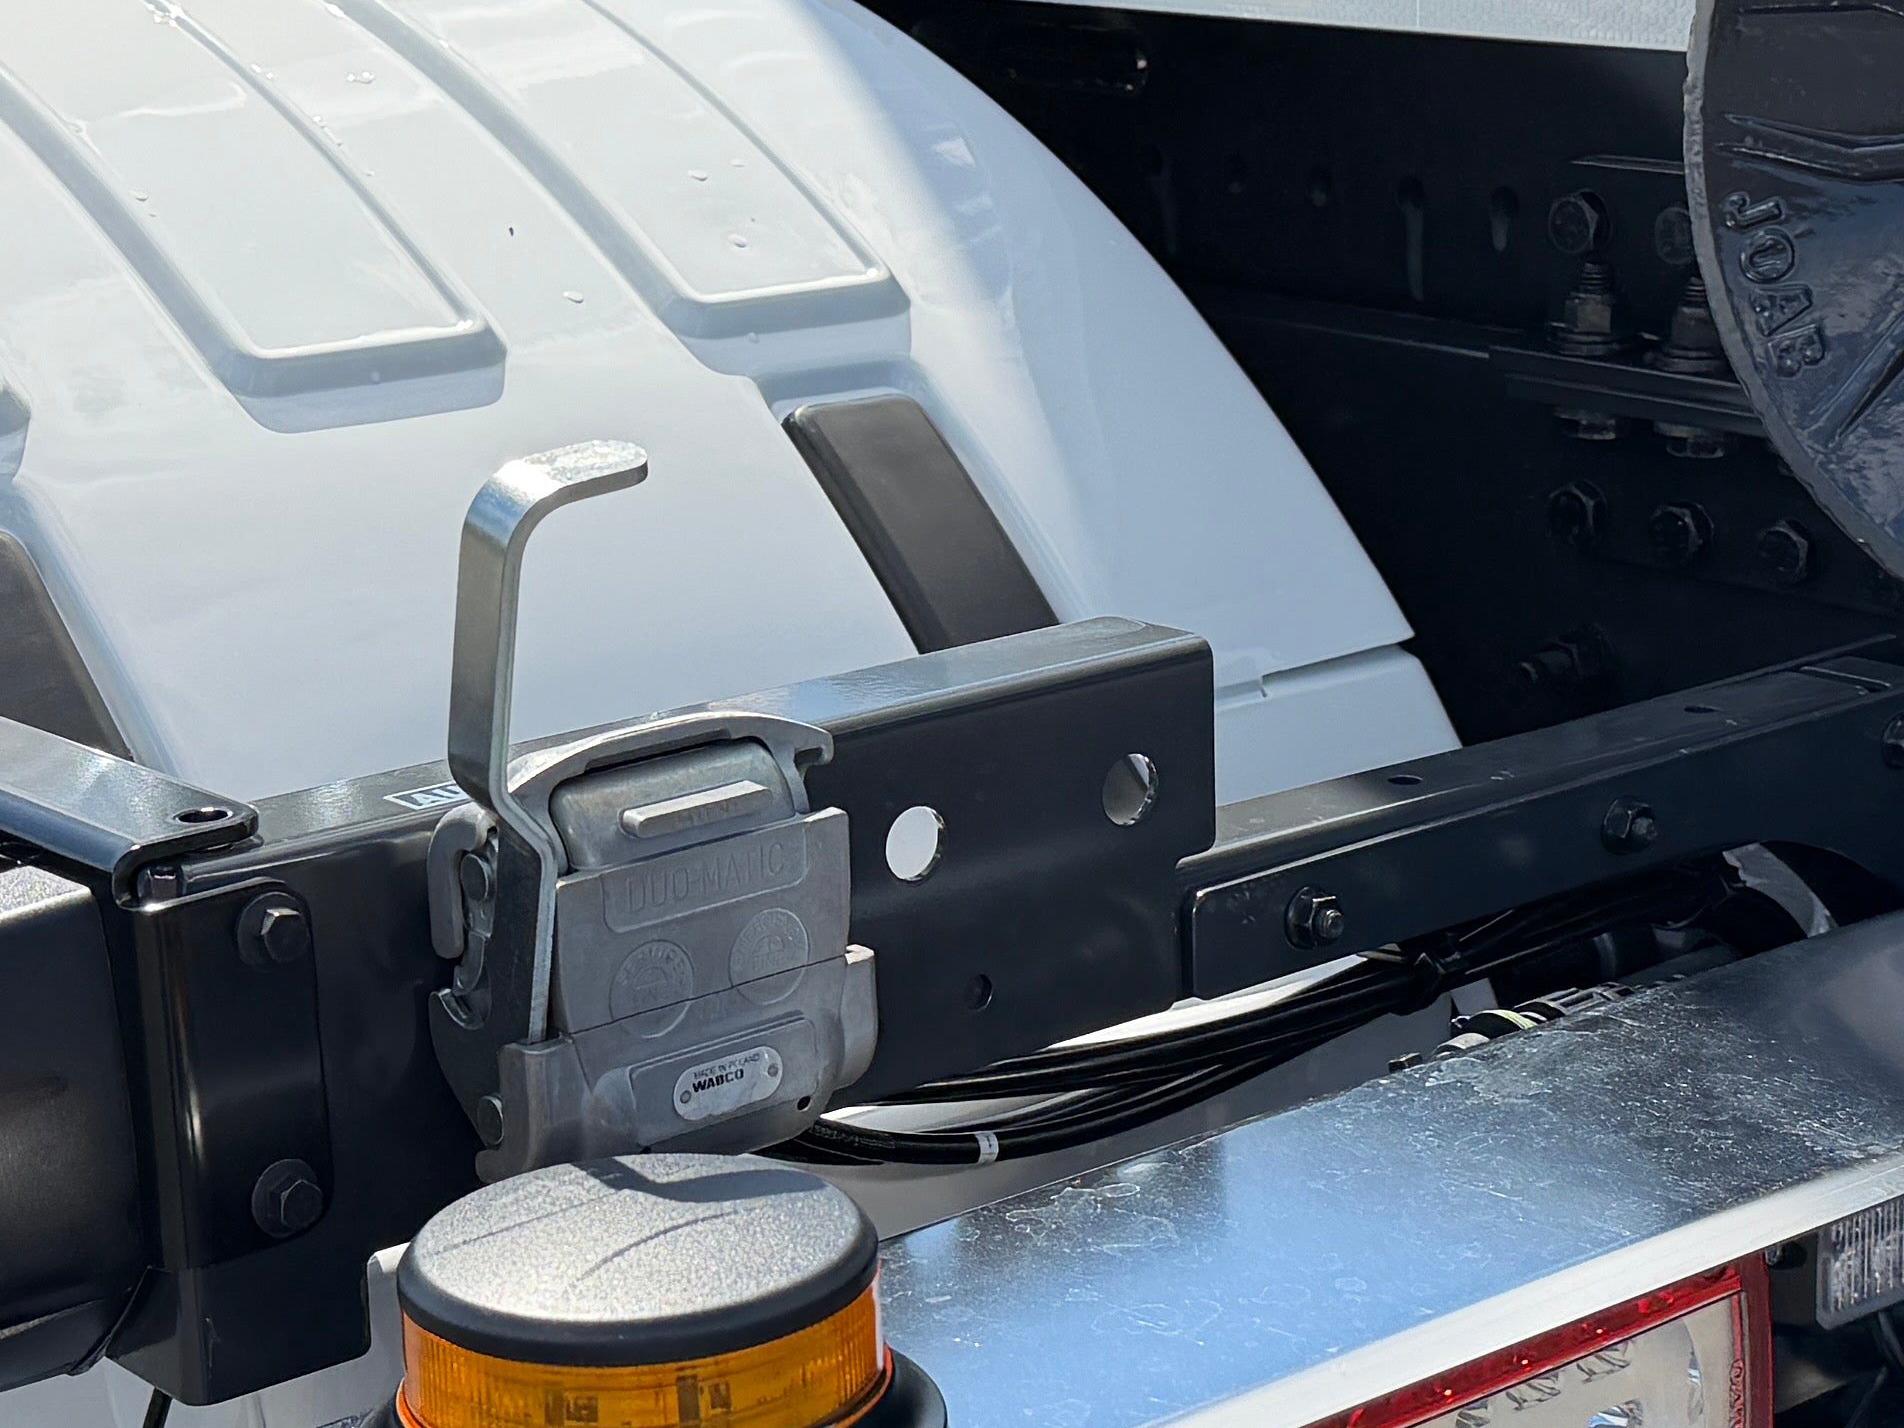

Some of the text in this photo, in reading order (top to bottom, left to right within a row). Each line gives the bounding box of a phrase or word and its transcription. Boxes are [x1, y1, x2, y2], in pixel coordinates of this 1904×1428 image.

[1723, 189, 1826, 379] JOAB
[410, 784, 469, 807] AU
[692, 1068, 745, 1093] WABCO
